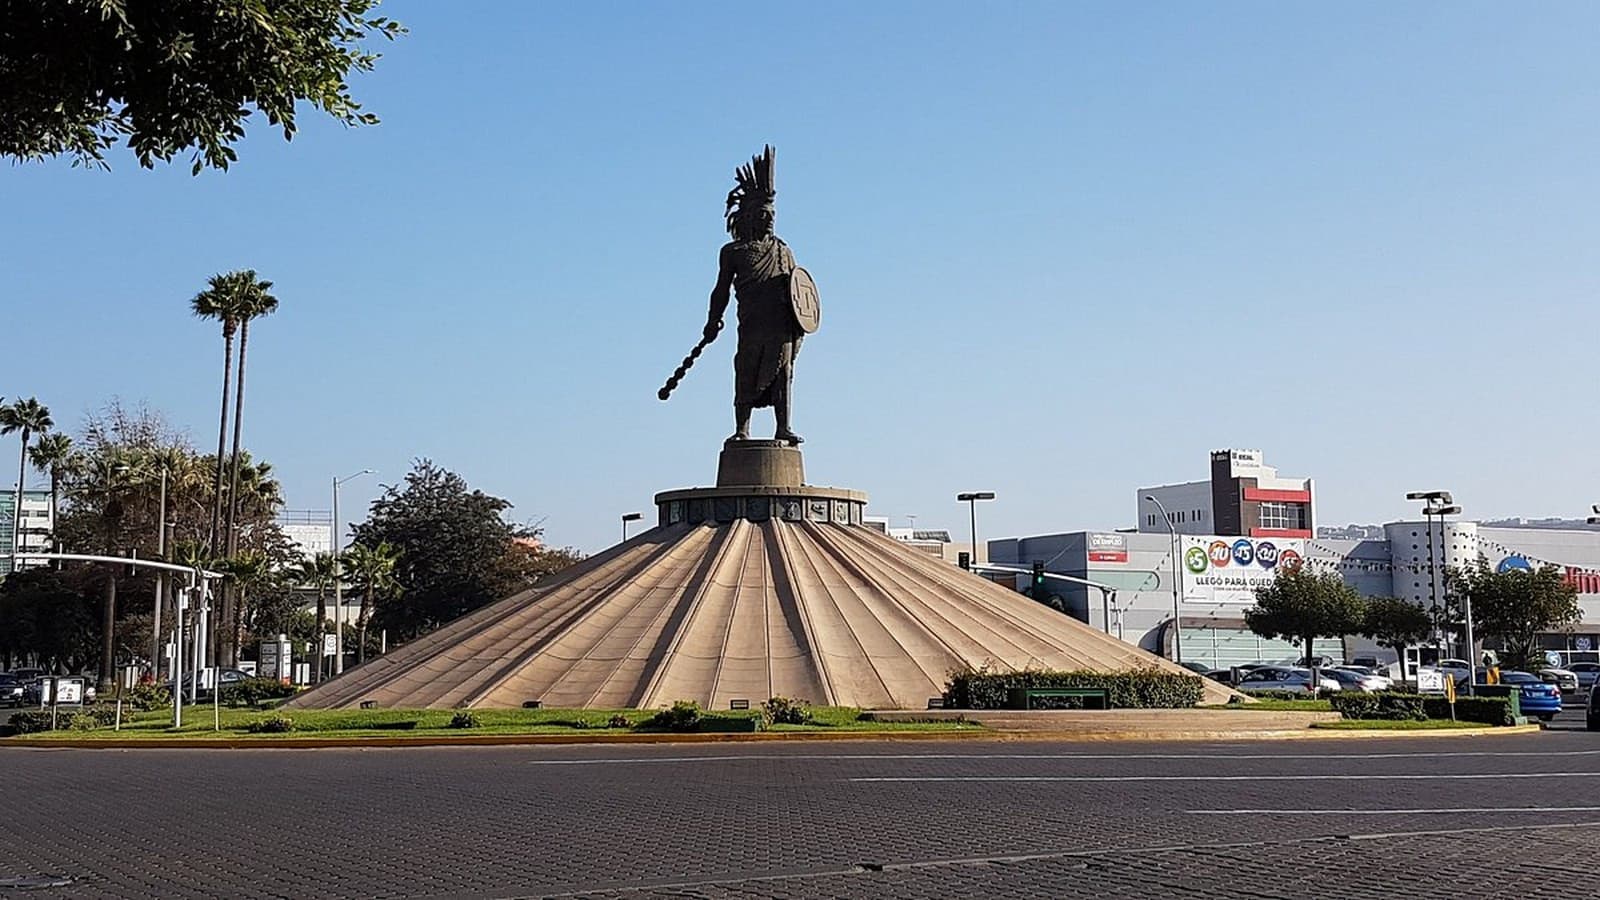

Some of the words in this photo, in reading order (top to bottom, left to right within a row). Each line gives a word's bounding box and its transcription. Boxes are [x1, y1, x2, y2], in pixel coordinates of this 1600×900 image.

[1195, 576, 1223, 586] LLEGÓ
[1225, 577, 1248, 586] PARA
[1249, 577, 1273, 587] QUED
